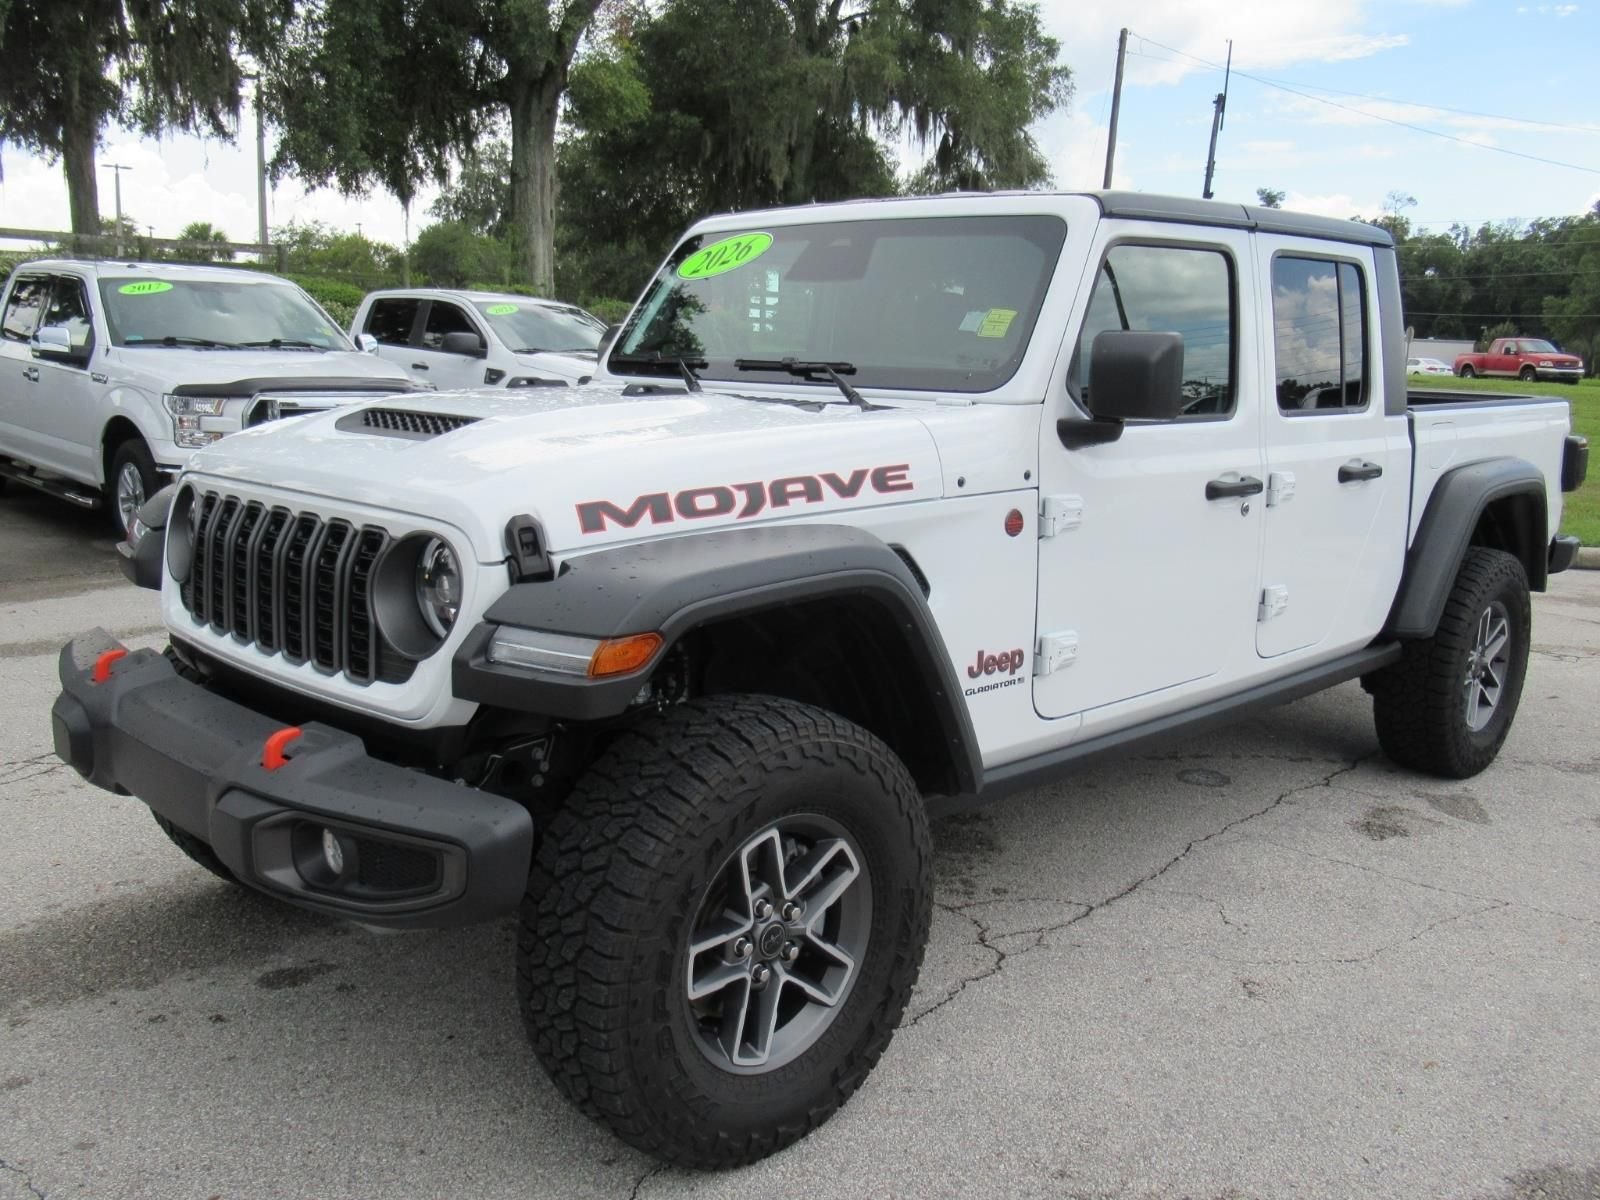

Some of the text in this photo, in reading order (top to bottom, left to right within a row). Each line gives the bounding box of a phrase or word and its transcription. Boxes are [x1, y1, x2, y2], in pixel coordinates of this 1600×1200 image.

[688, 236, 757, 275] 2026
[575, 463, 914, 535] MOJAVE
[967, 648, 1025, 679] Jeep
[965, 678, 1017, 696] GLADIATOR
